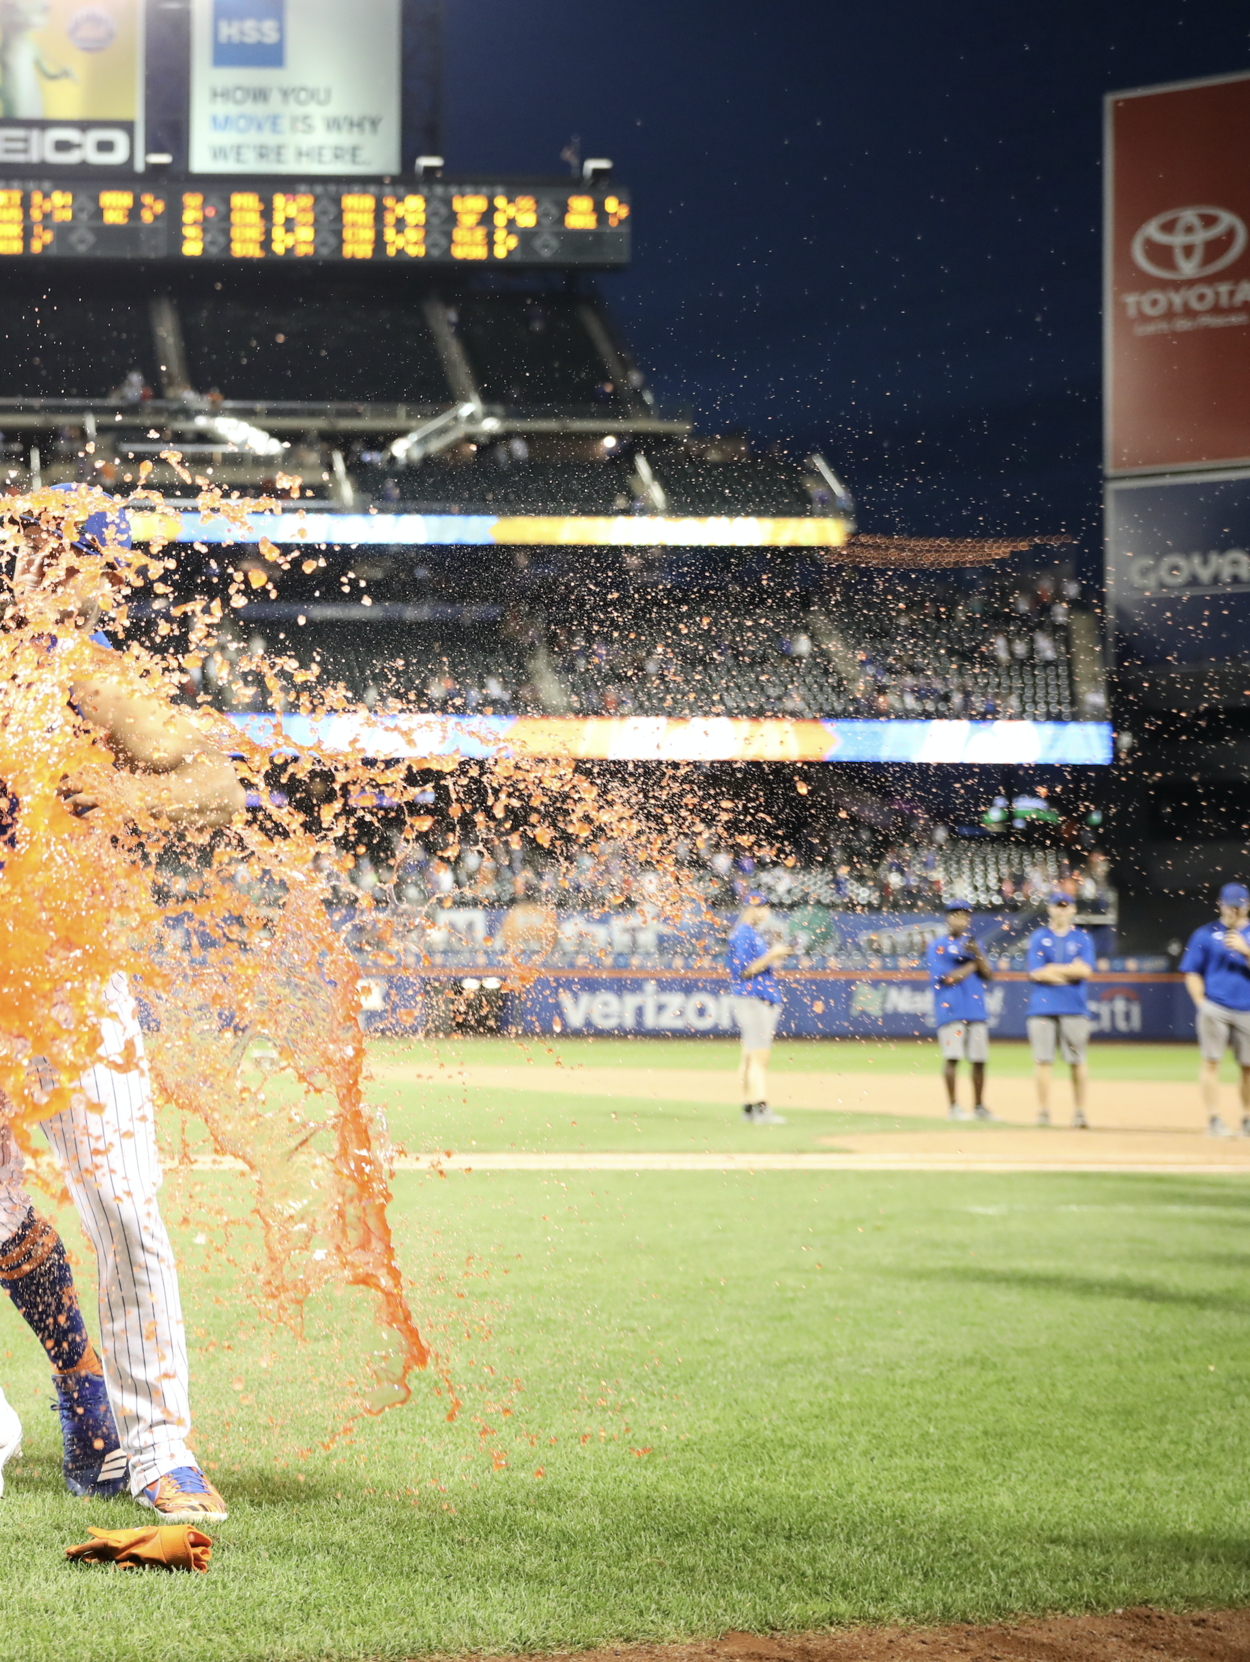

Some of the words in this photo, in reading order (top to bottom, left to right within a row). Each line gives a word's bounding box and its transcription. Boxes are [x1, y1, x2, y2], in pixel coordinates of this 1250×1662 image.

[217, 18, 281, 45] HSS
[210, 86, 273, 107] HOW
[277, 86, 333, 106] YOU
[210, 113, 285, 135] MOVE
[291, 114, 314, 135] IS
[325, 114, 384, 136] WHY
[209, 144, 287, 164] WE'RE
[294, 144, 371, 165] HERE.
[1119, 277, 1250, 320] TOYOTA
[1131, 548, 1250, 592] GOYA
